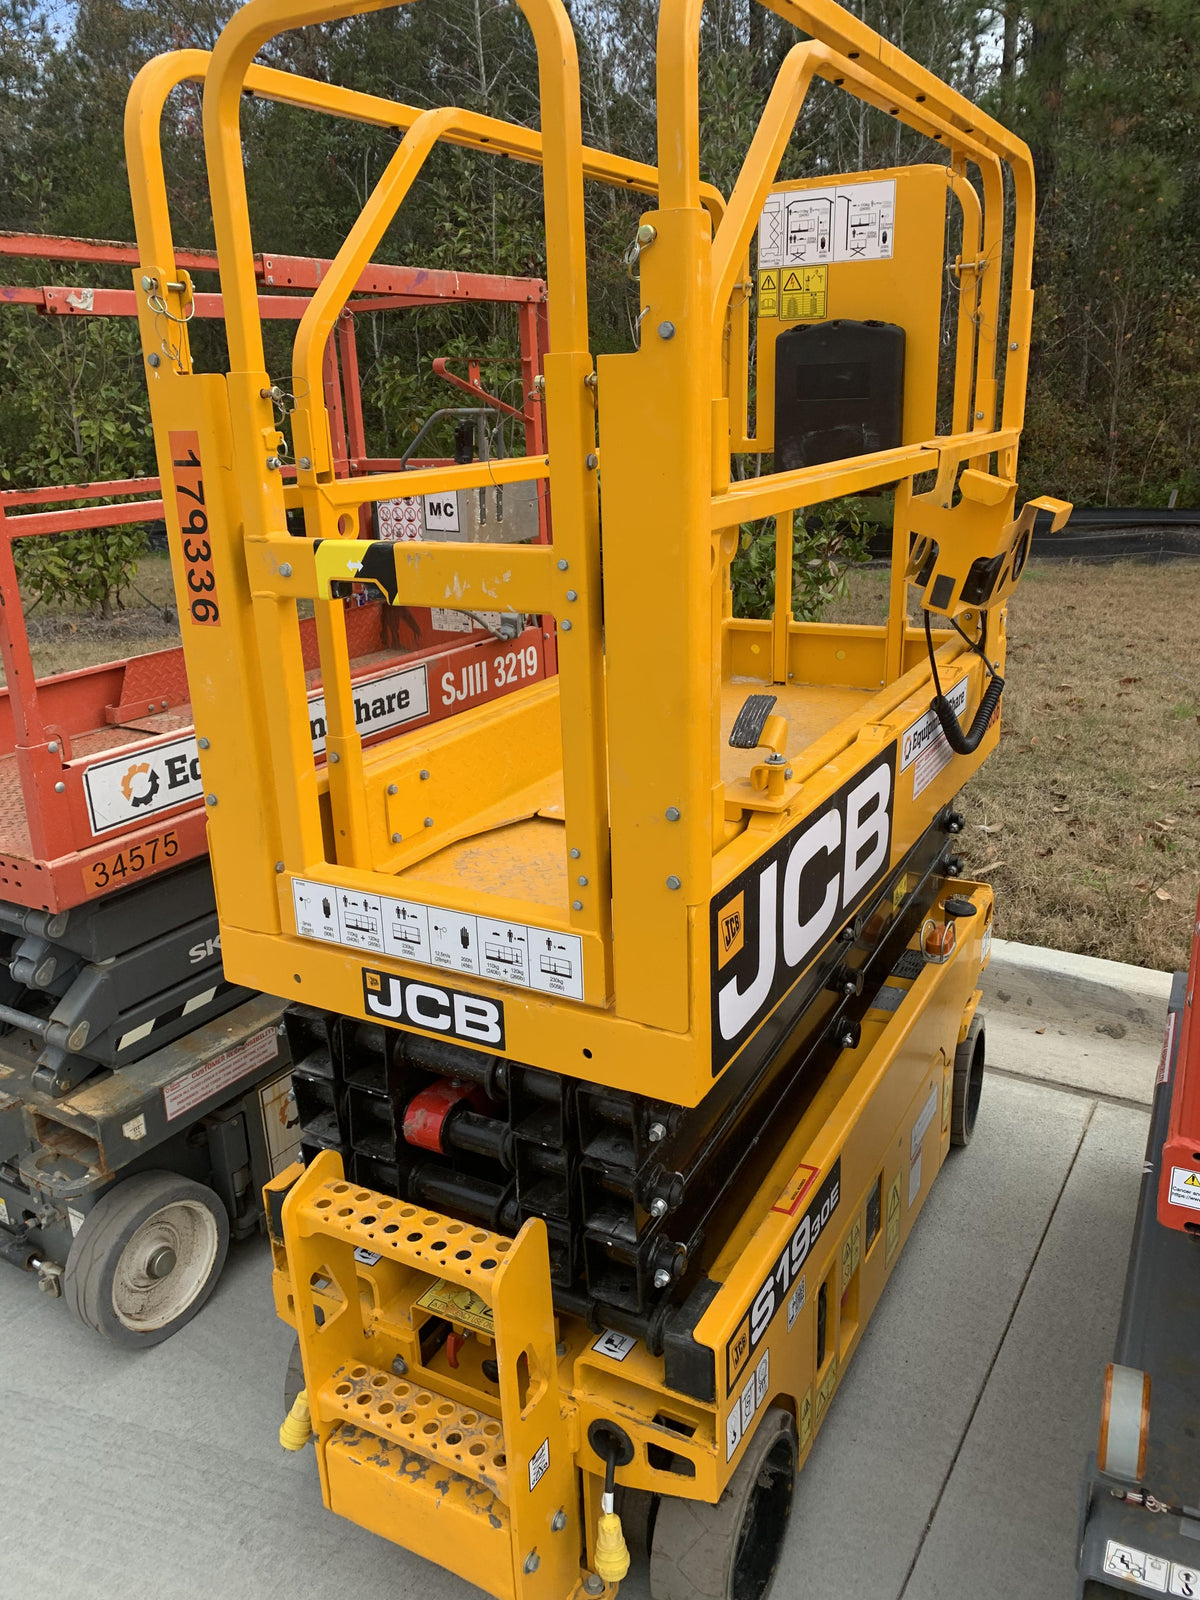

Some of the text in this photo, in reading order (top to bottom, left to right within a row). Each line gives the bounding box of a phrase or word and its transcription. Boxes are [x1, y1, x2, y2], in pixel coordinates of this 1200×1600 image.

[174, 450, 219, 622] 179336
[429, 502, 454, 518] MC
[441, 645, 538, 706] SJIII 3219
[92, 831, 178, 888] 34575
[719, 763, 891, 1041] JCB
[725, 914, 740, 947] JCB
[368, 977, 502, 1043] JCB
